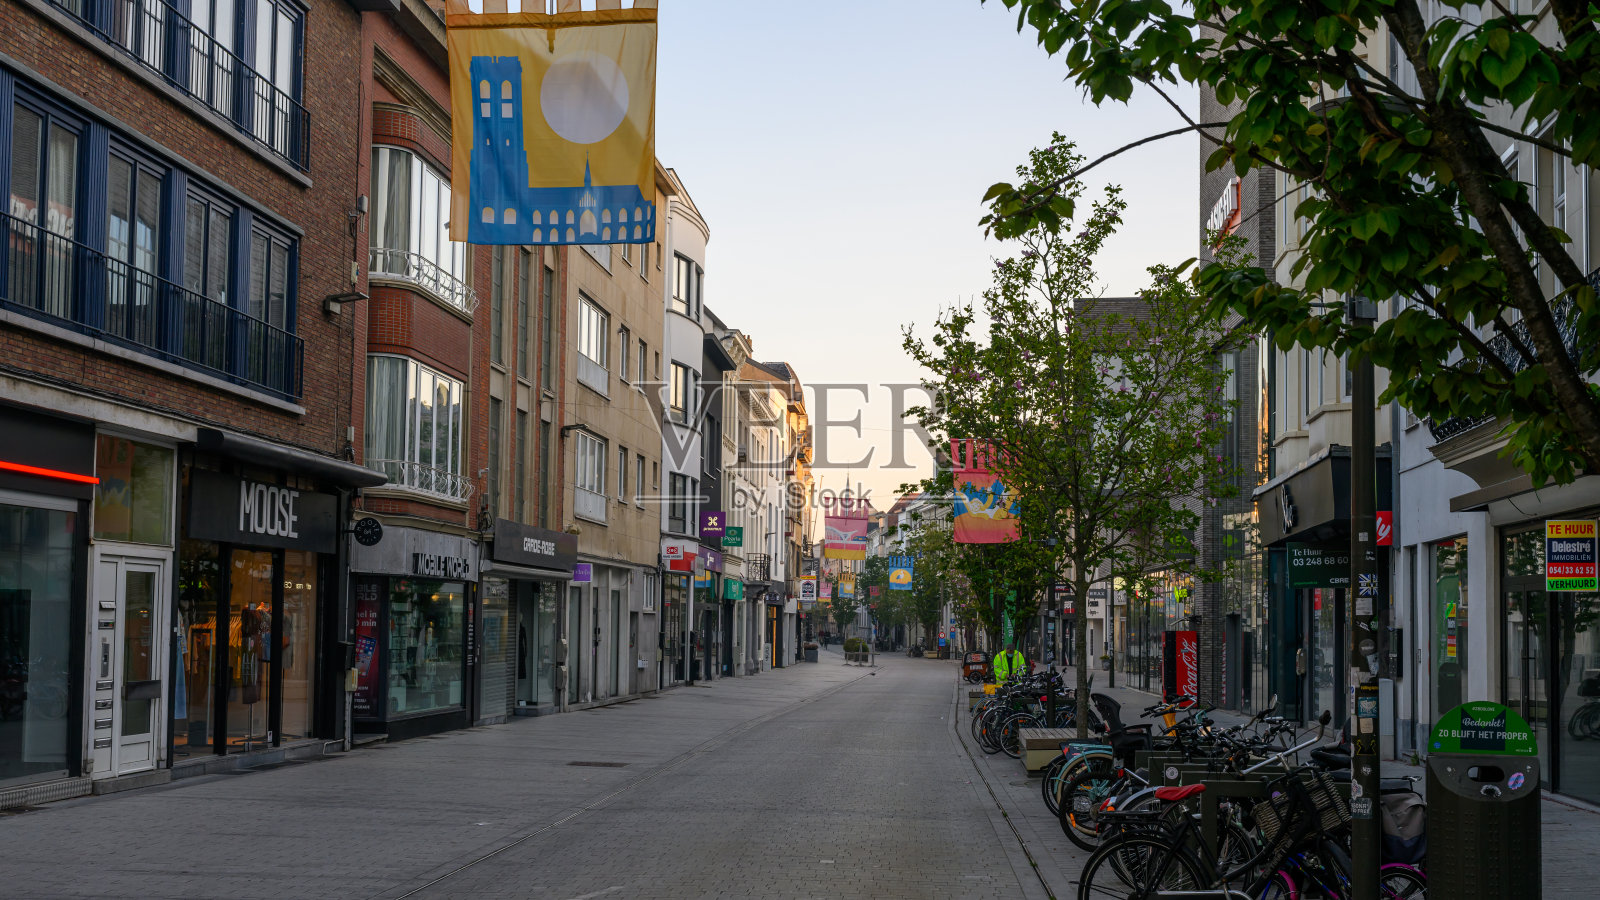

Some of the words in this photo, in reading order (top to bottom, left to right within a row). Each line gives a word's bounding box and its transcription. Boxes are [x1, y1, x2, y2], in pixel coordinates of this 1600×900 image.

[238, 480, 300, 539] MOOSE
[1549, 524, 1562, 534] TE
[1564, 524, 1594, 534] HUUR
[523, 537, 556, 556] GARDE-ROBE
[1551, 540, 1591, 552] Delestré
[413, 552, 446, 577] MOBILE
[1293, 558, 1304, 566] 03
[1305, 557, 1322, 565] 248
[1324, 557, 1336, 565] 68
[1549, 565, 1574, 575] 054/33
[1575, 566, 1584, 574] 62
[1585, 566, 1594, 574] 52
[1549, 579, 1595, 589] VERHUURD
[1462, 718, 1505, 728] Bedankt!
[1438, 729, 1449, 738] ZO
[1478, 731, 1495, 740] HET
[1496, 732, 1528, 741] PROPER
